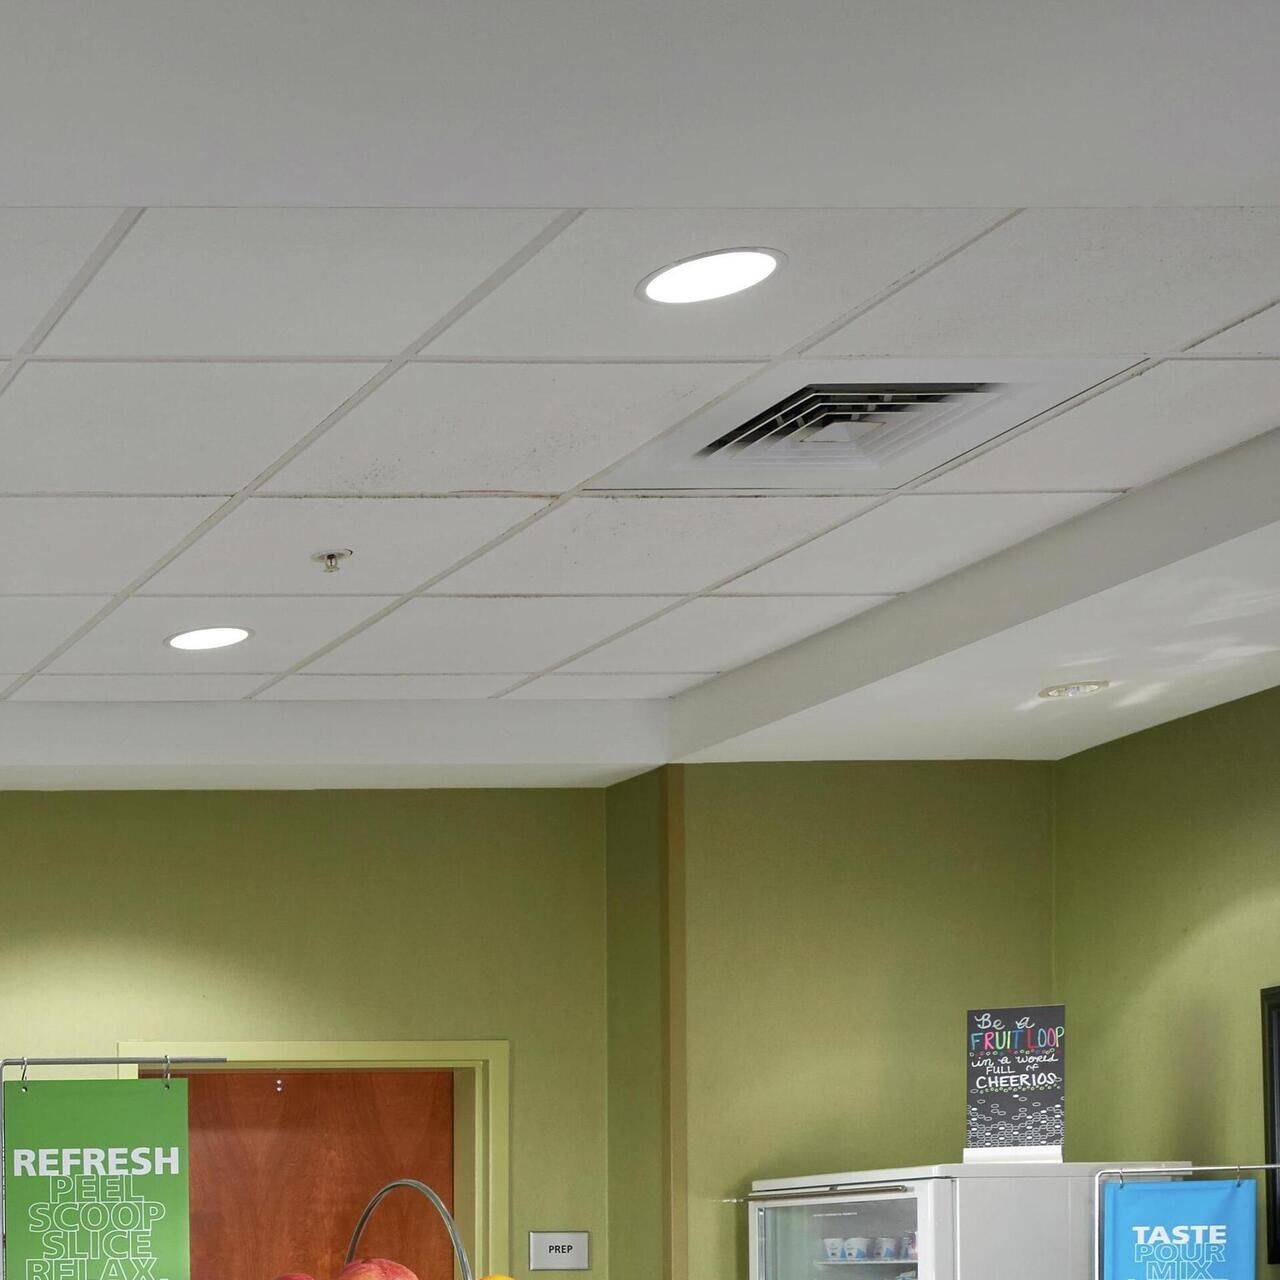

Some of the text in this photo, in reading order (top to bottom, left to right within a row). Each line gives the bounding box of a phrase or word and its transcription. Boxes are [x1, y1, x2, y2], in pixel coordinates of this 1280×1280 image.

[974, 1013, 1036, 1030] Be a
[971, 1026, 1065, 1050] FRUIT LOOP
[998, 1056, 1011, 1064] a
[986, 1065, 1016, 1075] FULL
[976, 1072, 1058, 1089] CHEERIOS
[13, 1147, 180, 1177] REFRESH
[49, 1173, 145, 1204] PEEL
[28, 1201, 166, 1233] SCOOP
[1132, 1225, 1227, 1244] TASTE
[42, 1230, 153, 1260] SLICE
[548, 1245, 573, 1253] PREP
[1134, 1243, 1226, 1263] POUR
[1146, 1261, 1213, 1280] MIX
